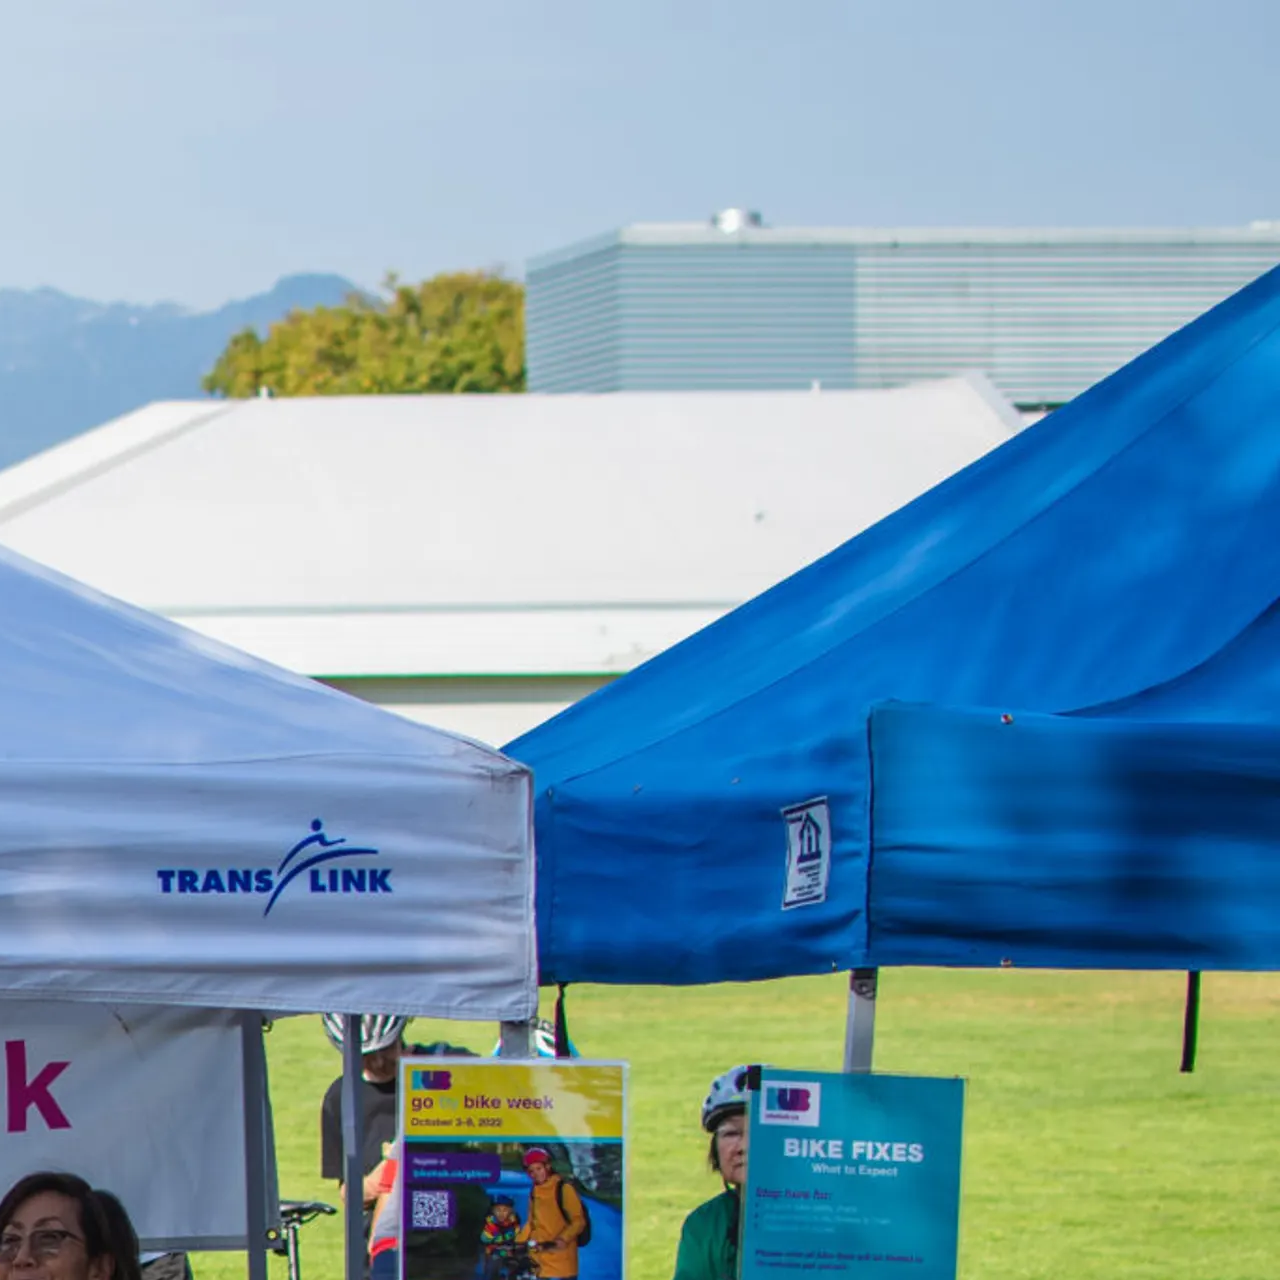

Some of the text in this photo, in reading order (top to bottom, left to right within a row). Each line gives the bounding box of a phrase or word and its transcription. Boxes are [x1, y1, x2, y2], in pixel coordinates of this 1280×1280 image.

[412, 1097, 434, 1112] go
[464, 1095, 502, 1109] bike
[506, 1095, 554, 1109] week
[411, 1117, 453, 1127] October
[784, 1137, 924, 1163] BIKE FIXES
[811, 1162, 898, 1178] What to Expect
